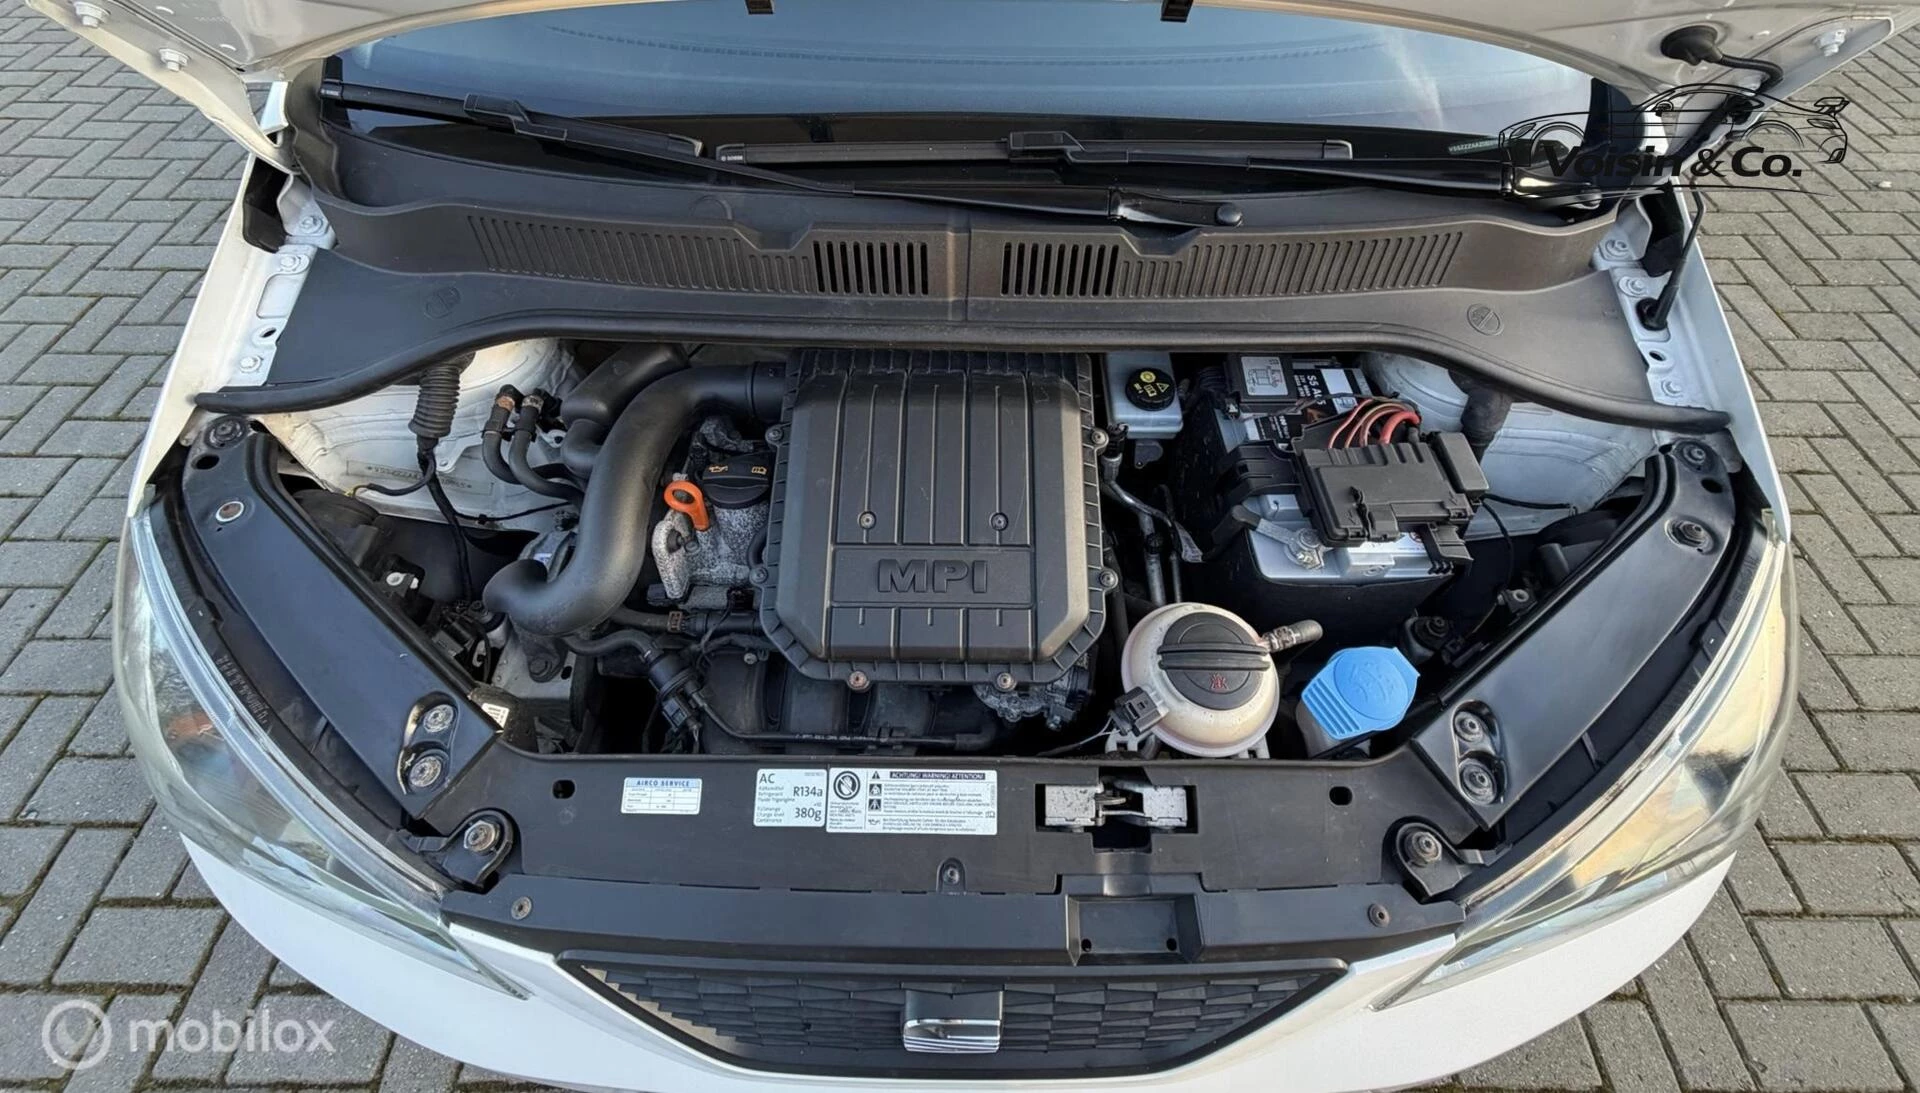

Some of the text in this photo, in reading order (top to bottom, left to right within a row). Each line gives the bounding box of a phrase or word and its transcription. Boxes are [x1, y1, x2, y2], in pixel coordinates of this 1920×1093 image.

[878, 558, 988, 594] MPI
[759, 773, 776, 784] AC
[793, 786, 823, 797] R134a
[794, 807, 822, 822] 380g
